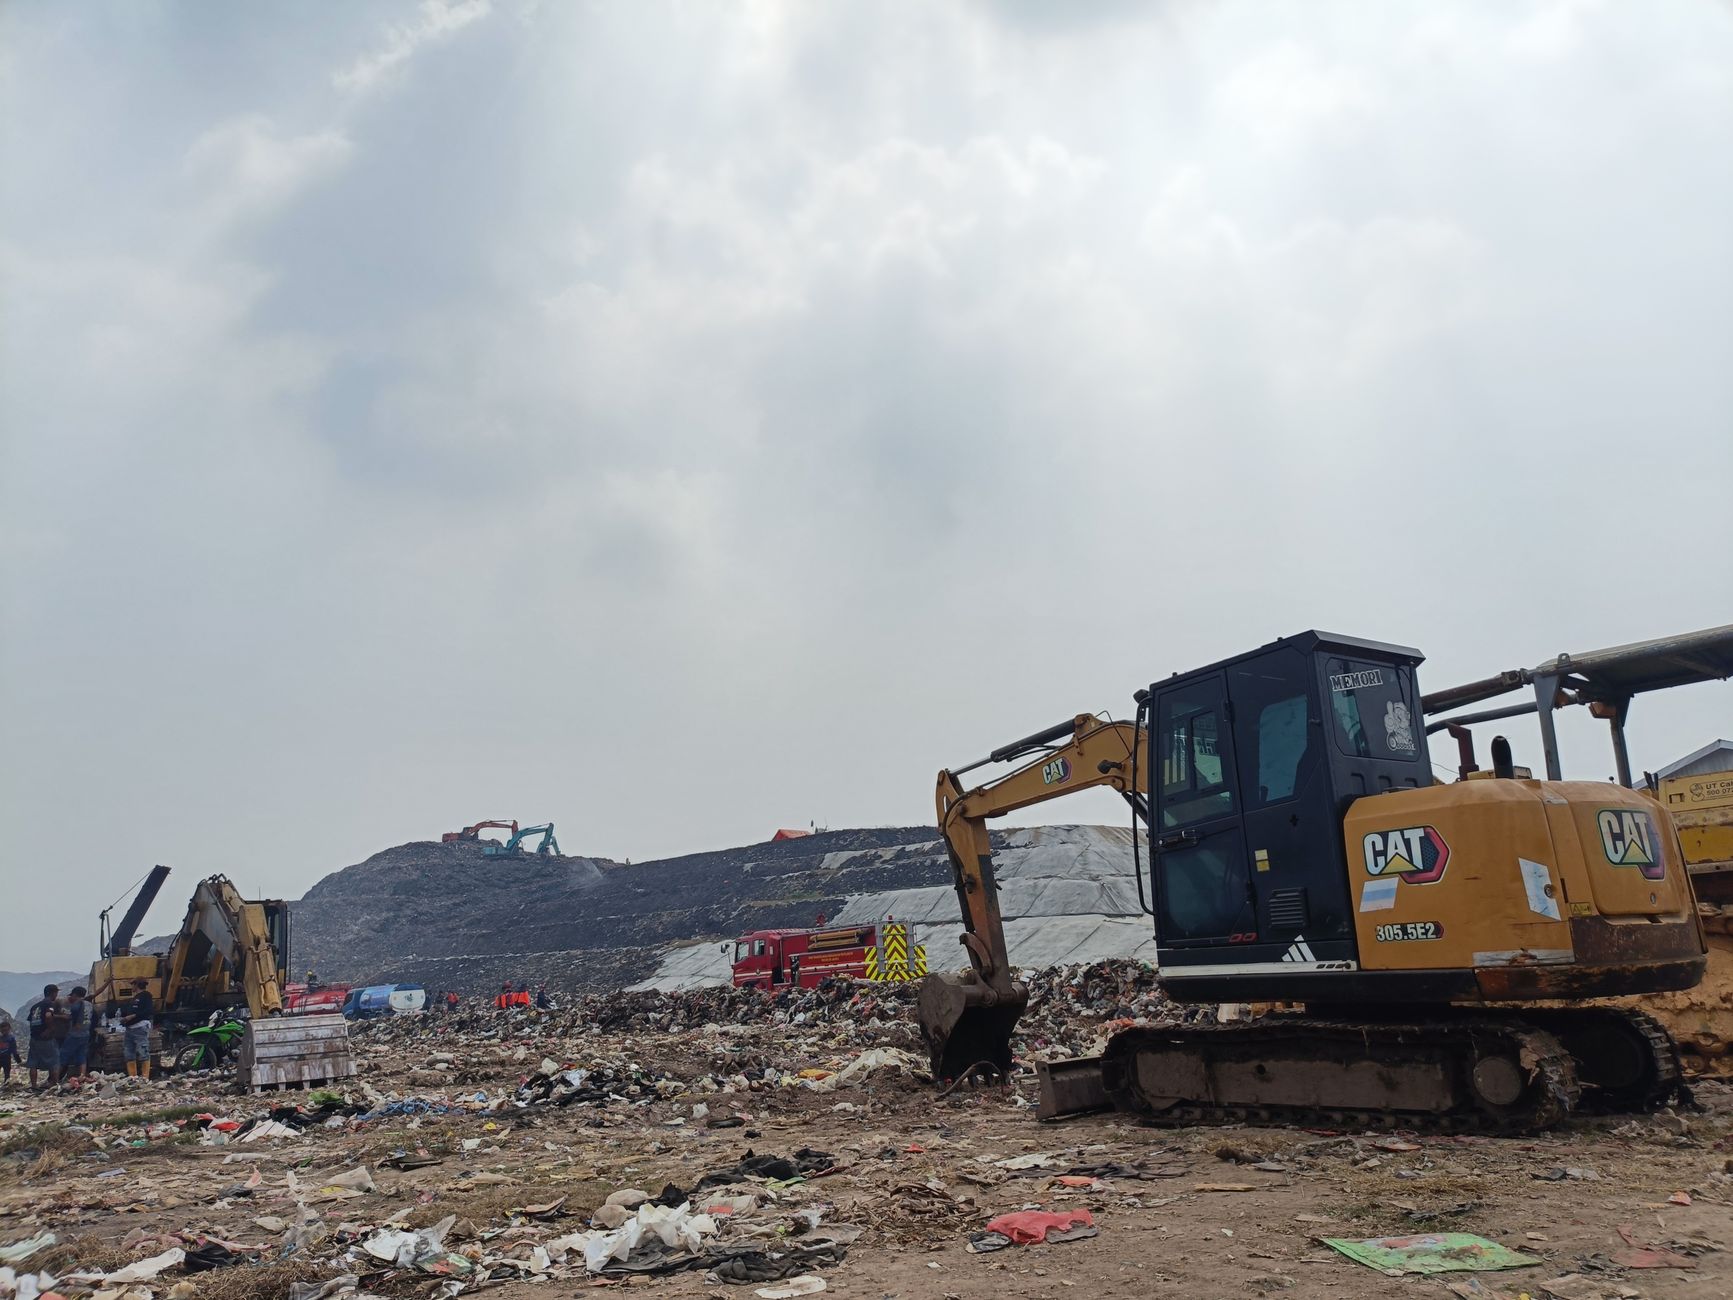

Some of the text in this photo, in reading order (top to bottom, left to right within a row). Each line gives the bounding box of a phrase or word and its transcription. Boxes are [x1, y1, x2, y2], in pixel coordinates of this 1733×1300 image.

[1330, 669, 1383, 691] MEMORI
[1043, 758, 1064, 784] CAT
[1598, 811, 1653, 864] CAT
[1364, 827, 1425, 875] CAT
[1376, 922, 1437, 941] 305.5E2
